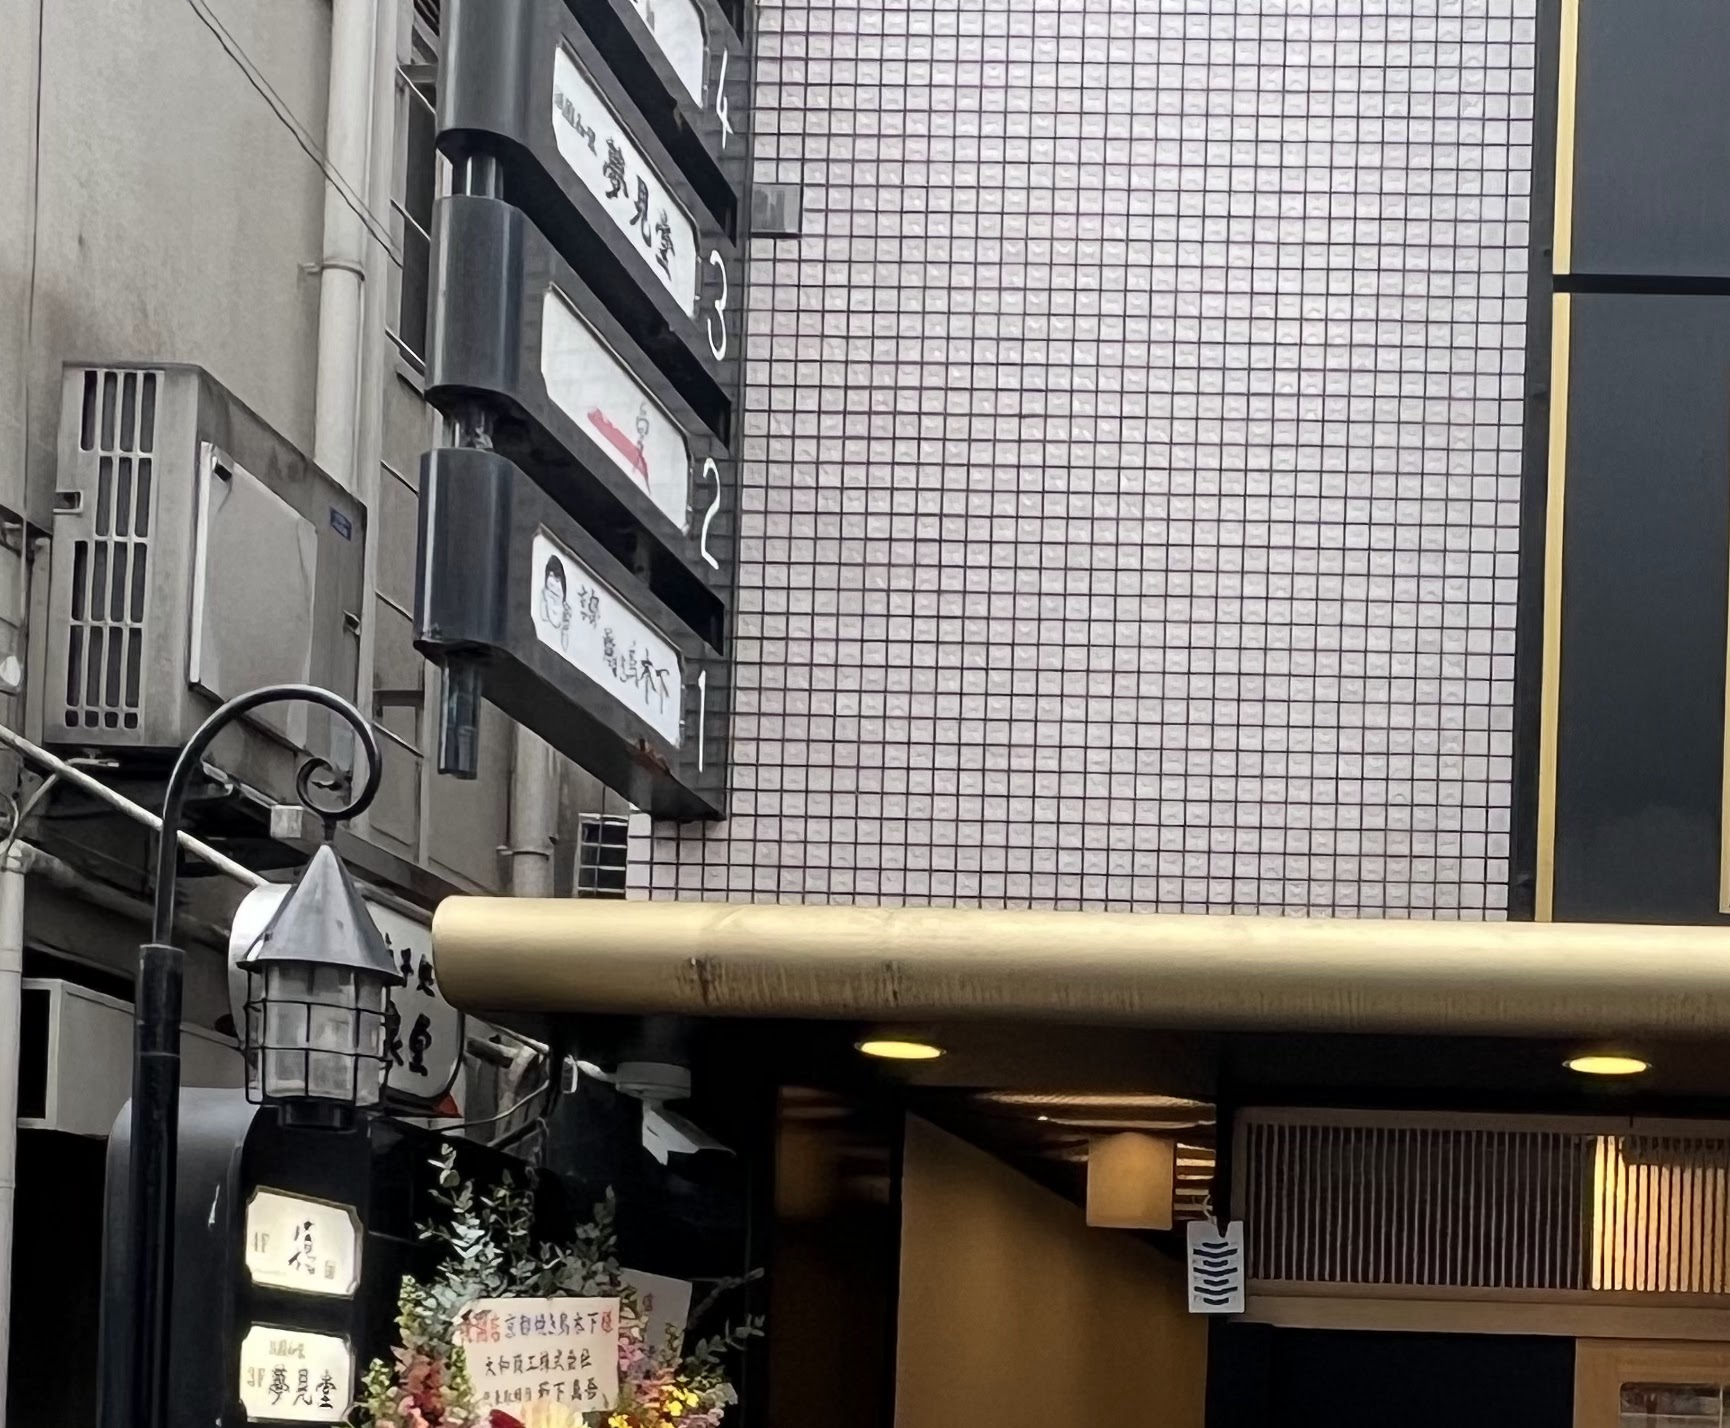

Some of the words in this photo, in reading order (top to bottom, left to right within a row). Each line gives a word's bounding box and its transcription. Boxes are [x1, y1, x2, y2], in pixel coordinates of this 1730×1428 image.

[706, 248, 728, 362] 3
[267, 1363, 338, 1410] 夢見堂
